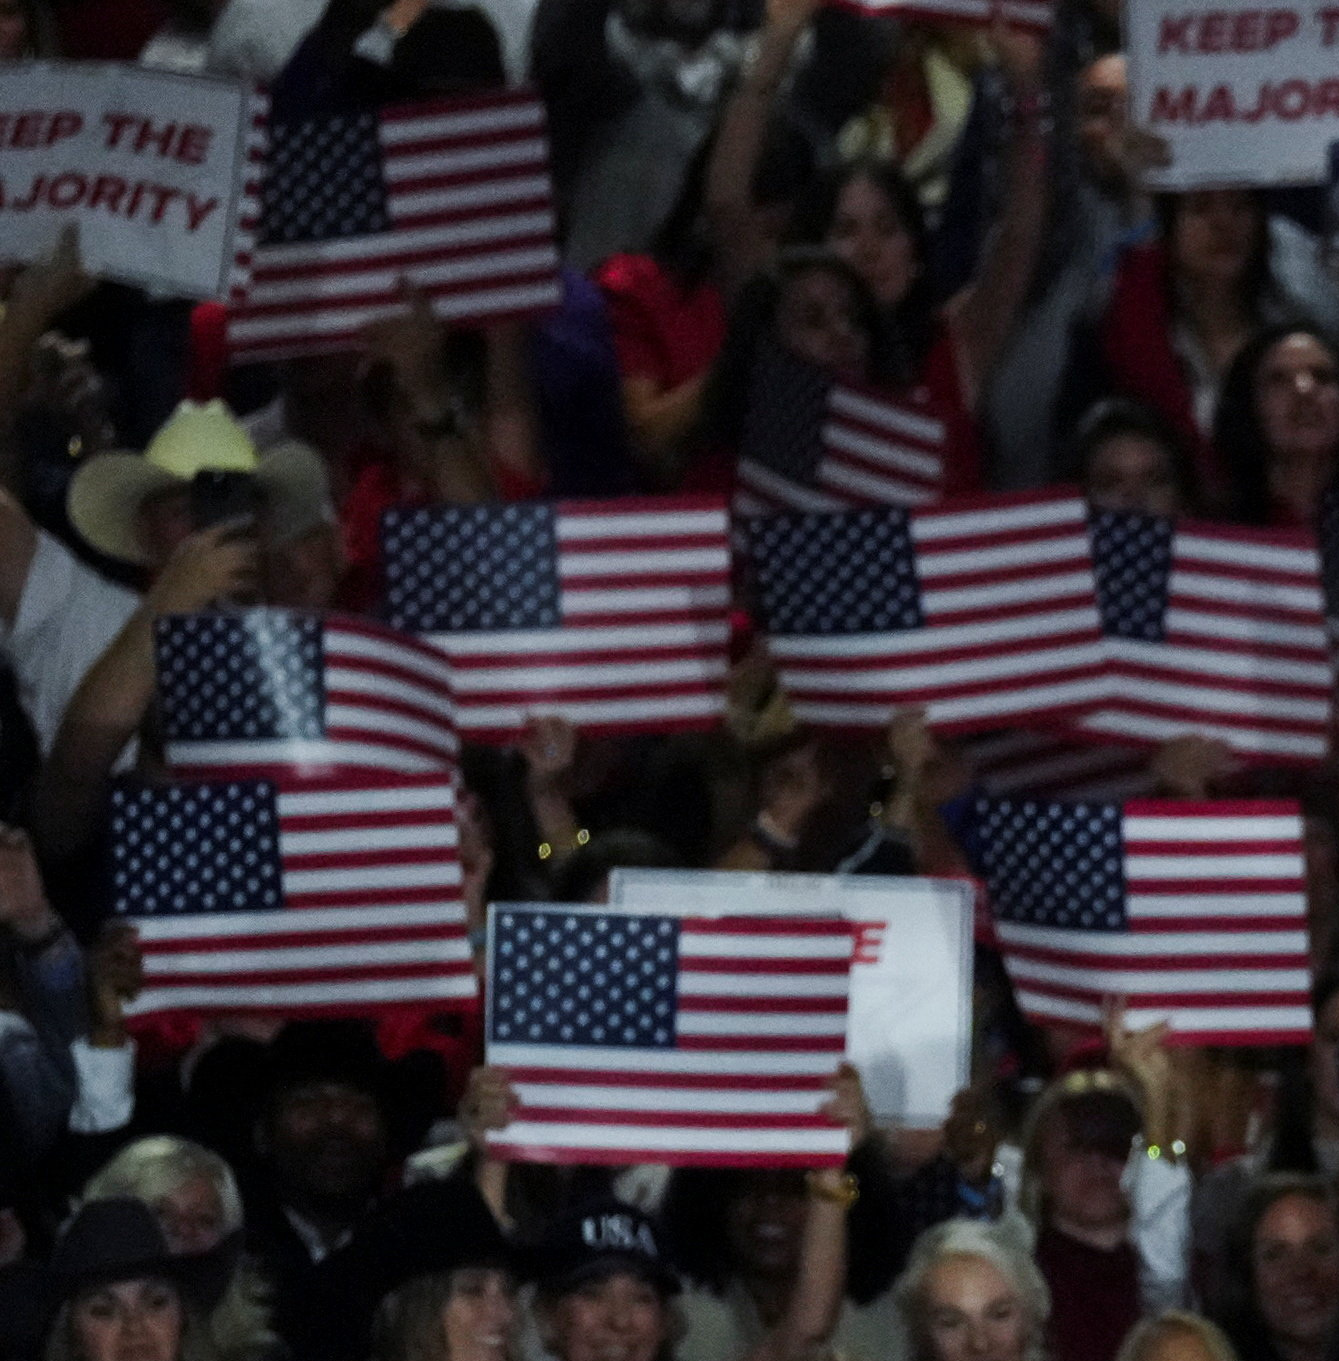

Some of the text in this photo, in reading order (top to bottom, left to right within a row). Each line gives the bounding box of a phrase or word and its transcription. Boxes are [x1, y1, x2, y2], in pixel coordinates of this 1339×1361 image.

[1156, 9, 1300, 54] KEEP
[0, 111, 213, 165] EP THE
[0, 171, 217, 231] JORITY
[582, 1213, 658, 1257] USA
